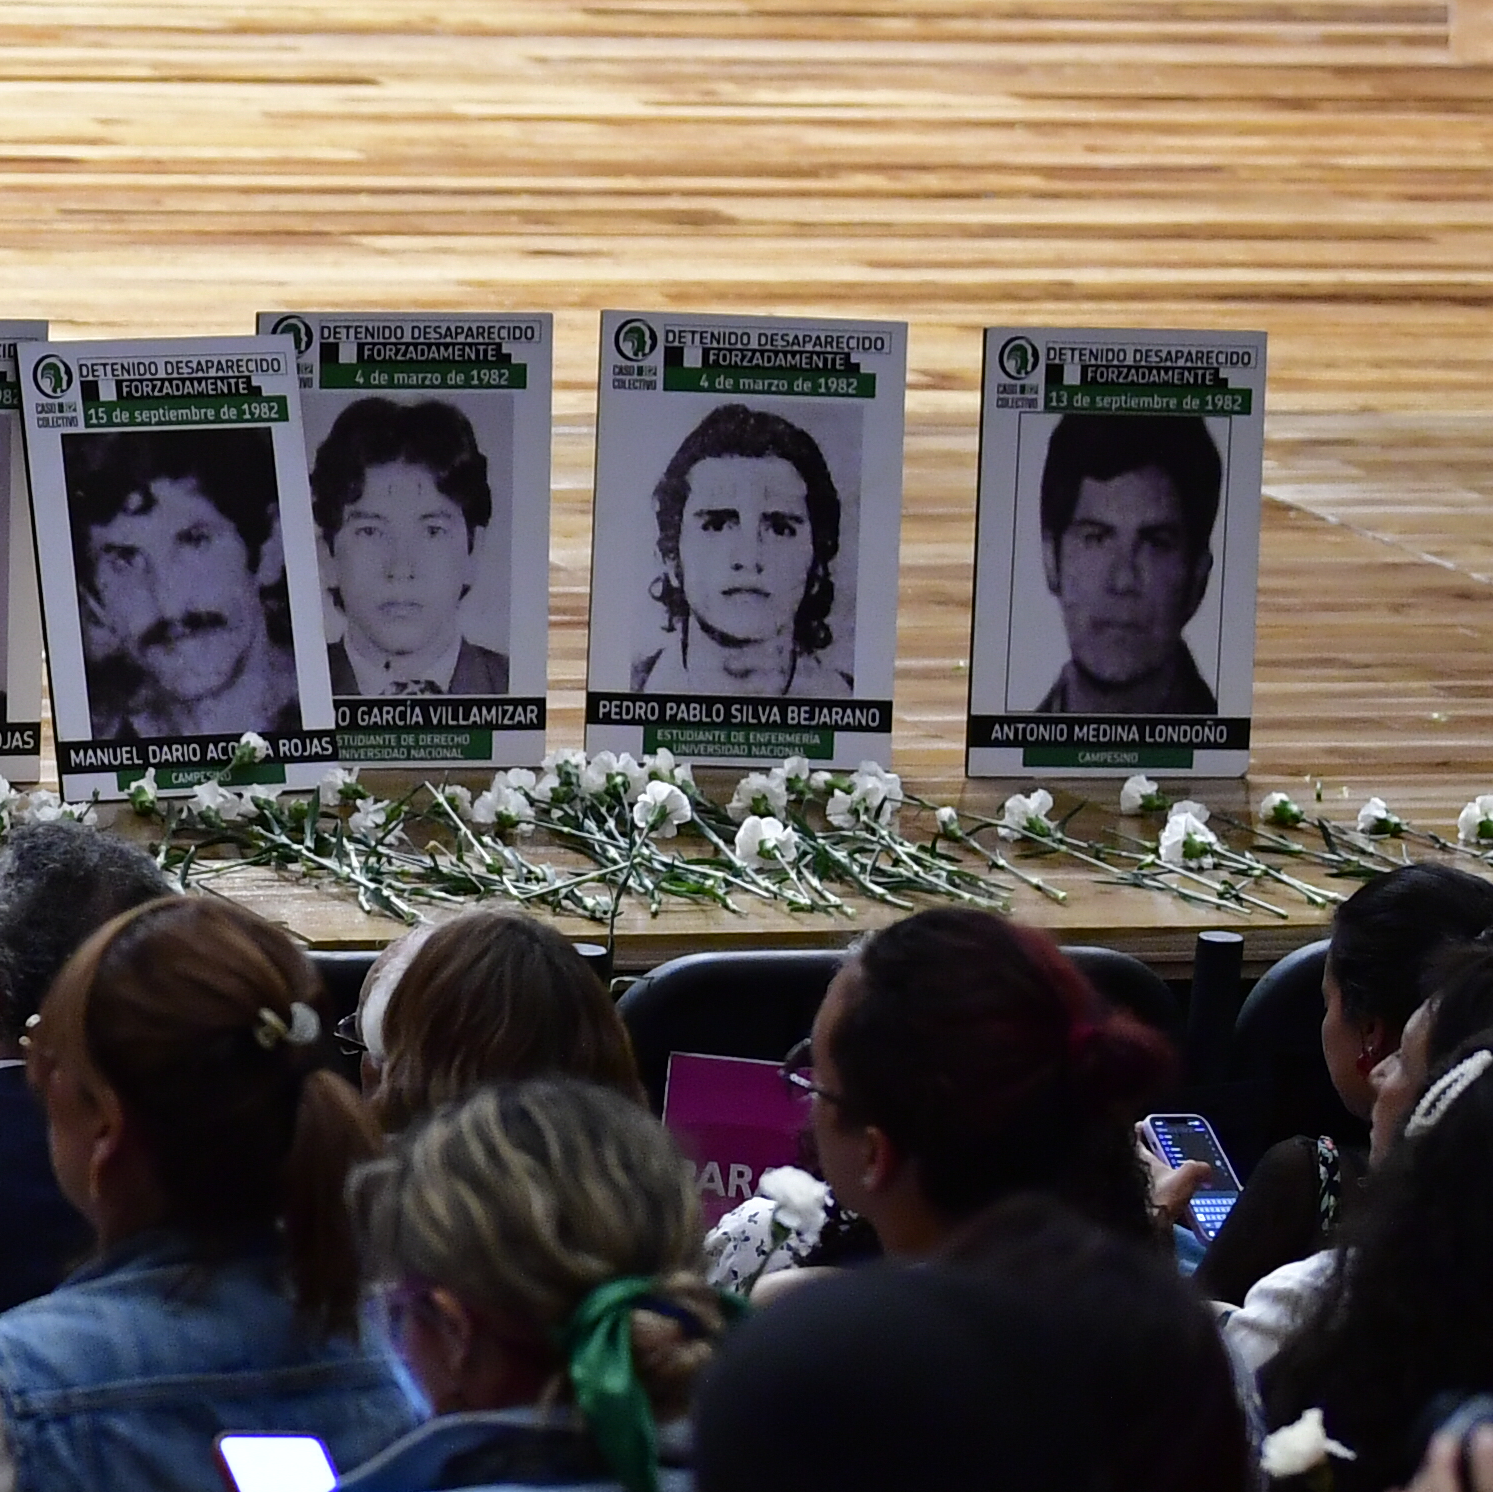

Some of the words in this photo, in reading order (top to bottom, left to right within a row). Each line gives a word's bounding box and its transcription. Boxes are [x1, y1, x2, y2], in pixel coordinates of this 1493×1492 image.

[321, 326, 404, 340] DETENIDO
[411, 325, 534, 340] DESAPARECIDO
[666, 329, 750, 346] DETENIDO
[758, 333, 884, 351] DESAPARECIDO
[364, 345, 496, 361] FORZADAMENTE
[709, 351, 845, 369] FORZADAMENTE
[1047, 347, 1126, 363] DETENIDO
[1133, 349, 1251, 365] DESAPARECIDO
[80, 361, 156, 378] DETENIDO
[164, 357, 281, 375] DESAPARECIDO
[1088, 368, 1214, 384] FORZADAMENTE
[123, 378, 247, 396] FORZADAMENTE
[358, 700, 423, 725] GARCÍA
[429, 706, 538, 724] VILLAMIZAR
[599, 700, 658, 721] PEDRO
[666, 703, 724, 722] PABLO
[731, 705, 780, 724] SILVA
[788, 706, 879, 726] BEJARANO
[336, 735, 396, 745] STUDIANTE
[401, 735, 414, 745] DE
[419, 734, 470, 745] DERECHO
[657, 729, 727, 742] ESTUDIANTE
[731, 732, 745, 742] DE
[750, 731, 820, 744] ENFERMERÍA
[992, 724, 1067, 741] ANTONIO
[1074, 724, 1139, 742] MEDINA
[1146, 721, 1227, 743] LONDOÑO
[70, 746, 143, 767] MANUEL
[149, 744, 201, 763] DARIO
[279, 738, 333, 756] ROJAS
[411, 747, 463, 758] NACIONAL
[673, 743, 748, 755] UNIVERSIDAD
[751, 745, 805, 756] NACIONAL
[1079, 752, 1138, 763] CAMPESINO
